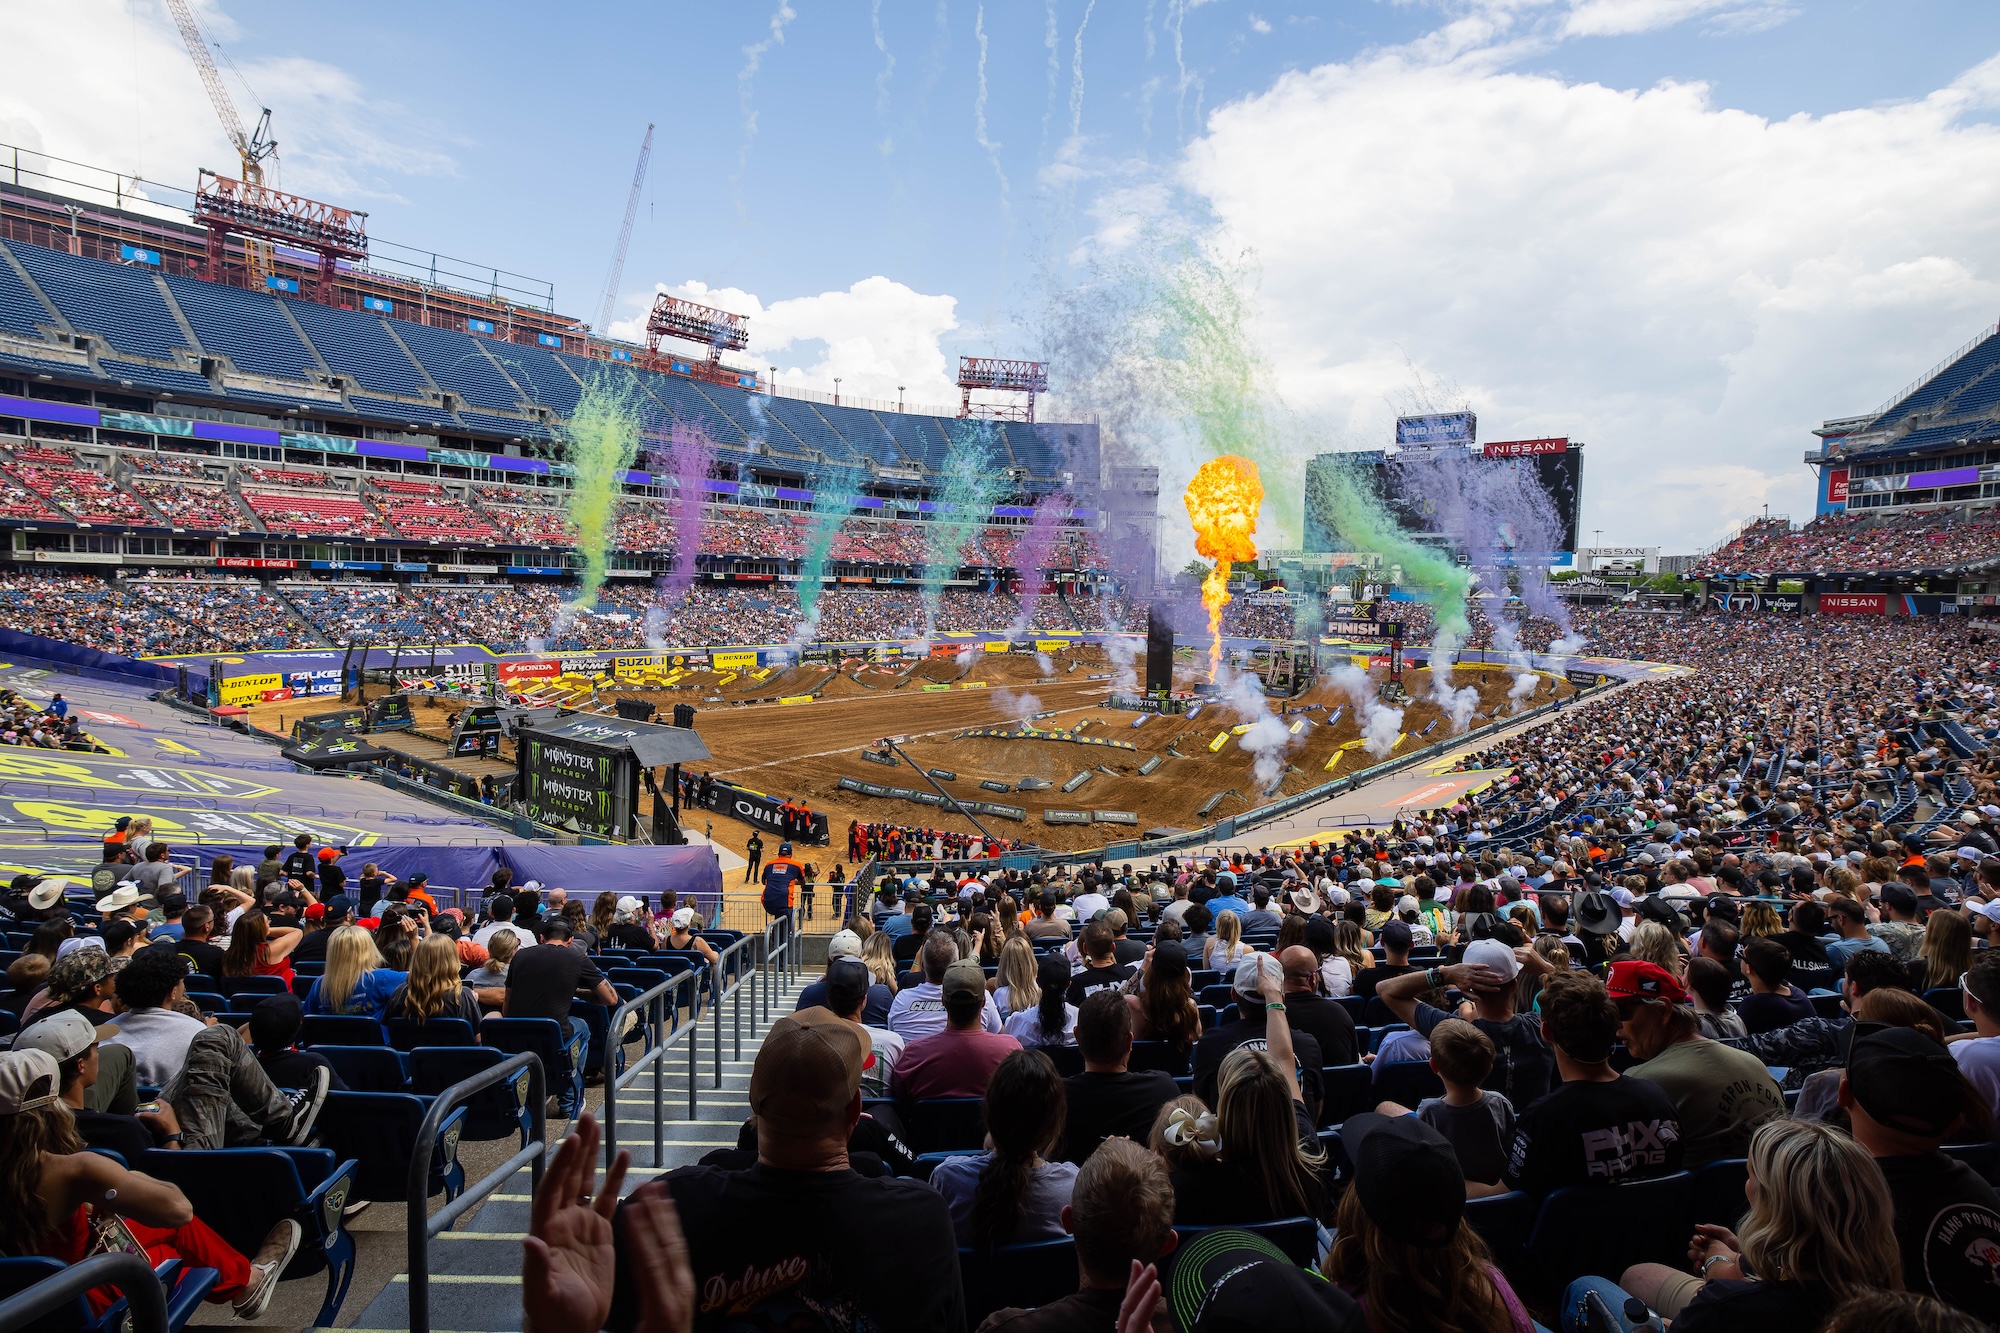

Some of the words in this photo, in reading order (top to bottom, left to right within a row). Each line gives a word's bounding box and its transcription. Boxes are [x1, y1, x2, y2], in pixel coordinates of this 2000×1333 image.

[1403, 427, 1427, 437] BUD
[1430, 424, 1460, 435] LIGHT
[1494, 442, 1556, 454] NISSAN
[1397, 452, 1431, 461] Pinnacle
[1774, 597, 1797, 611] Kroger
[1827, 598, 1878, 606] NISSAN
[1336, 604, 1370, 618] SMX
[1329, 622, 1380, 635] FINISH
[617, 657, 664, 667] SUZUKI
[444, 663, 470, 677] 5.11
[230, 677, 277, 689] DUNLOP
[1148, 689, 1168, 700] SMX
[1121, 698, 1159, 709] MONSTER
[544, 747, 595, 772] MONSTER
[551, 766, 587, 780] ENERGY
[542, 779, 594, 805] MONSTER
[550, 798, 586, 813] ENERGY
[1717, 1080, 1753, 1126] WEAPON
[1581, 1119, 1667, 1163] PHX
[1587, 1150, 1667, 1178] RACING
[1937, 1215, 1963, 1246] HANG
[700, 1256, 807, 1313] Deluxe
